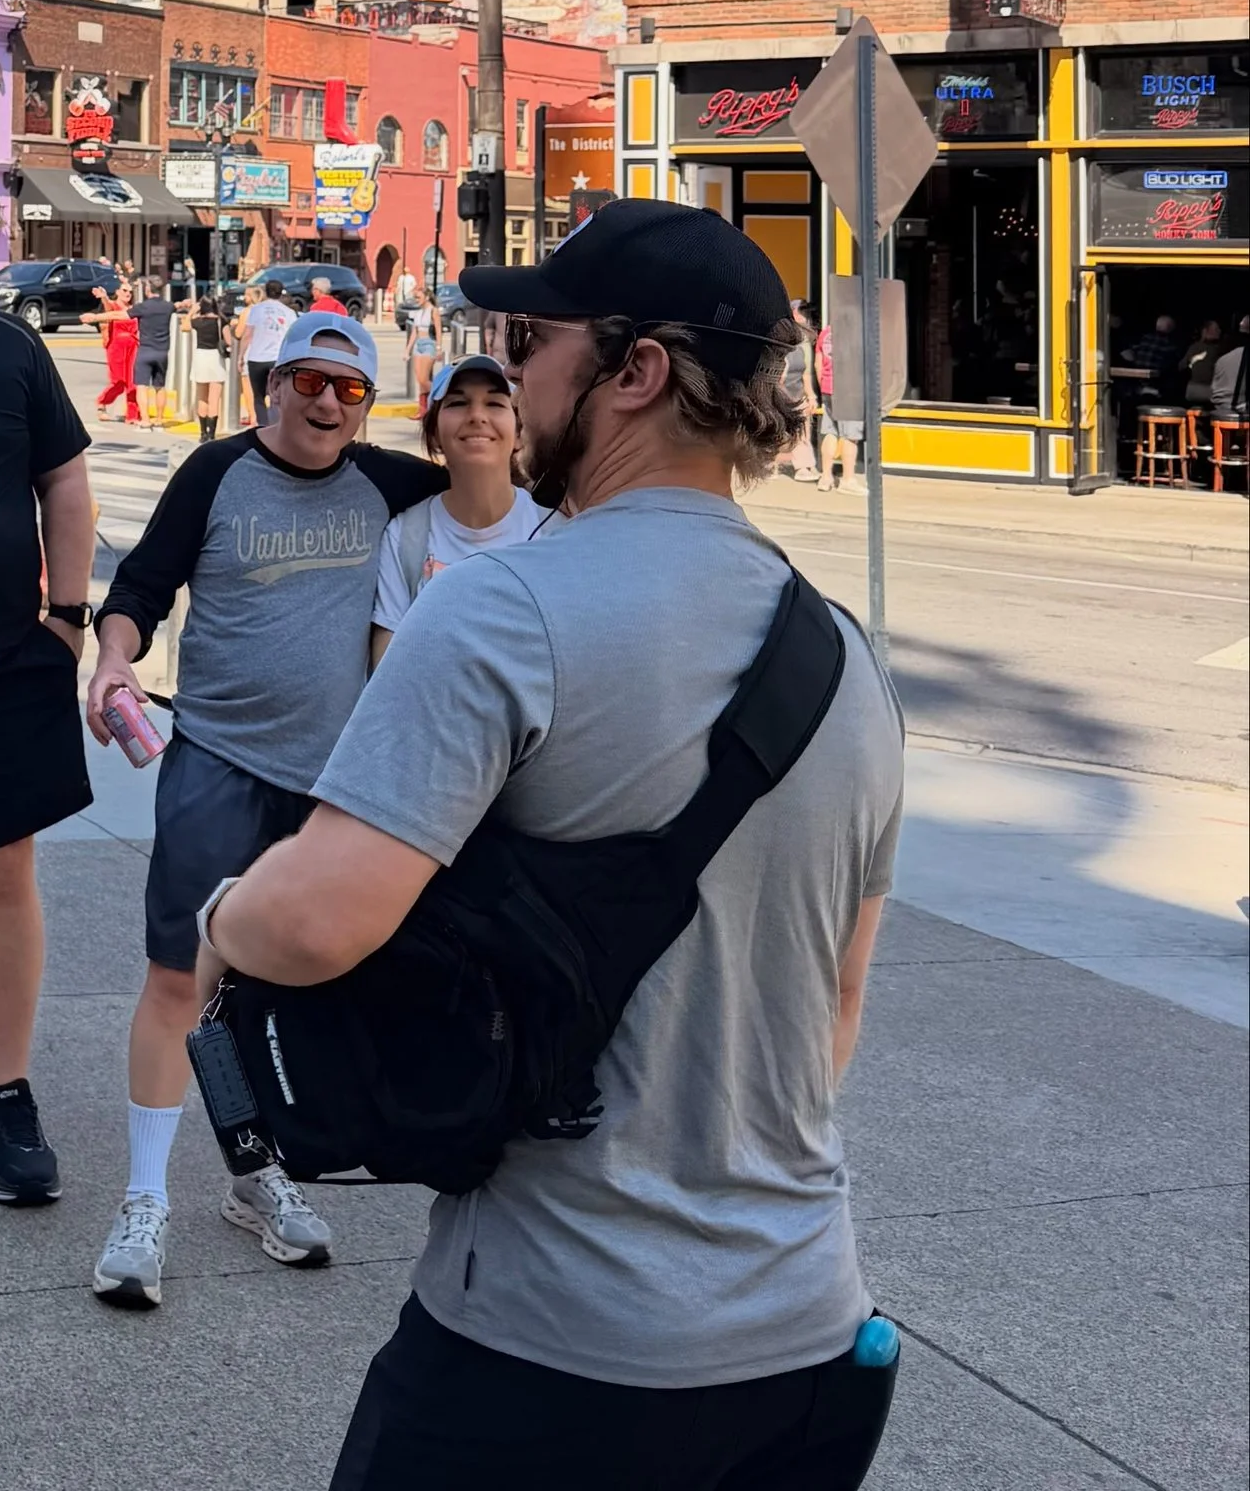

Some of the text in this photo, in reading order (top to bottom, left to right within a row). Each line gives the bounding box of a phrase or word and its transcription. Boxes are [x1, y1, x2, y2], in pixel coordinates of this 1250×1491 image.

[936, 87, 994, 100] ULTRA
[1142, 75, 1216, 96] BUSCH
[698, 76, 799, 125] Rippy's
[1155, 95, 1199, 107] LIGHT
[550, 137, 614, 151] The District
[1148, 174, 1223, 185] BUD LIGHT
[1147, 192, 1222, 226] Rippy's
[232, 509, 372, 563] Vanderbilt
